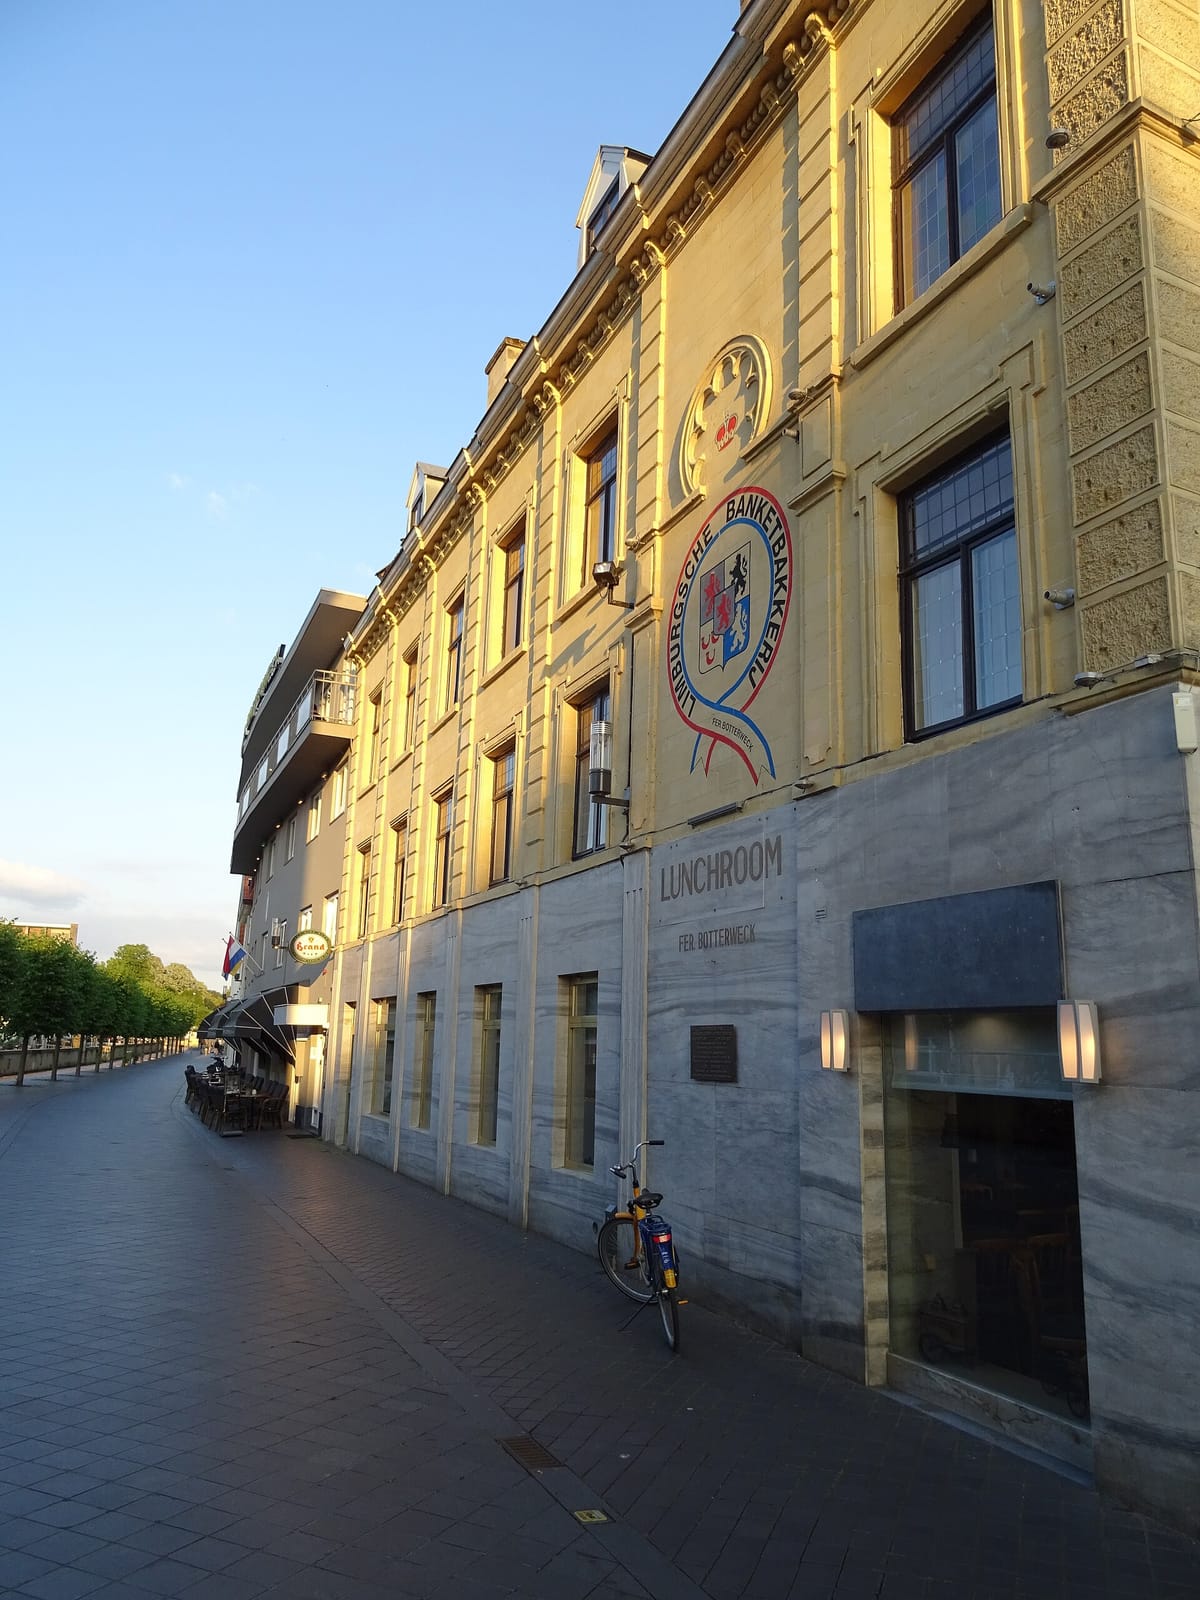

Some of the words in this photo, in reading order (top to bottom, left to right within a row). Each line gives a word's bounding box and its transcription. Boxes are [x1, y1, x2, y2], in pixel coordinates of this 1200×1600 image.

[670, 523, 713, 718] LIMBURGSCHE
[726, 494, 789, 689] BANKETBAKKERIJ
[722, 721, 753, 752] BOTTERWECK
[661, 835, 782, 901] LUNCHROOM
[296, 942, 325, 951] Brand
[698, 923, 755, 950] BOTTERWECK
